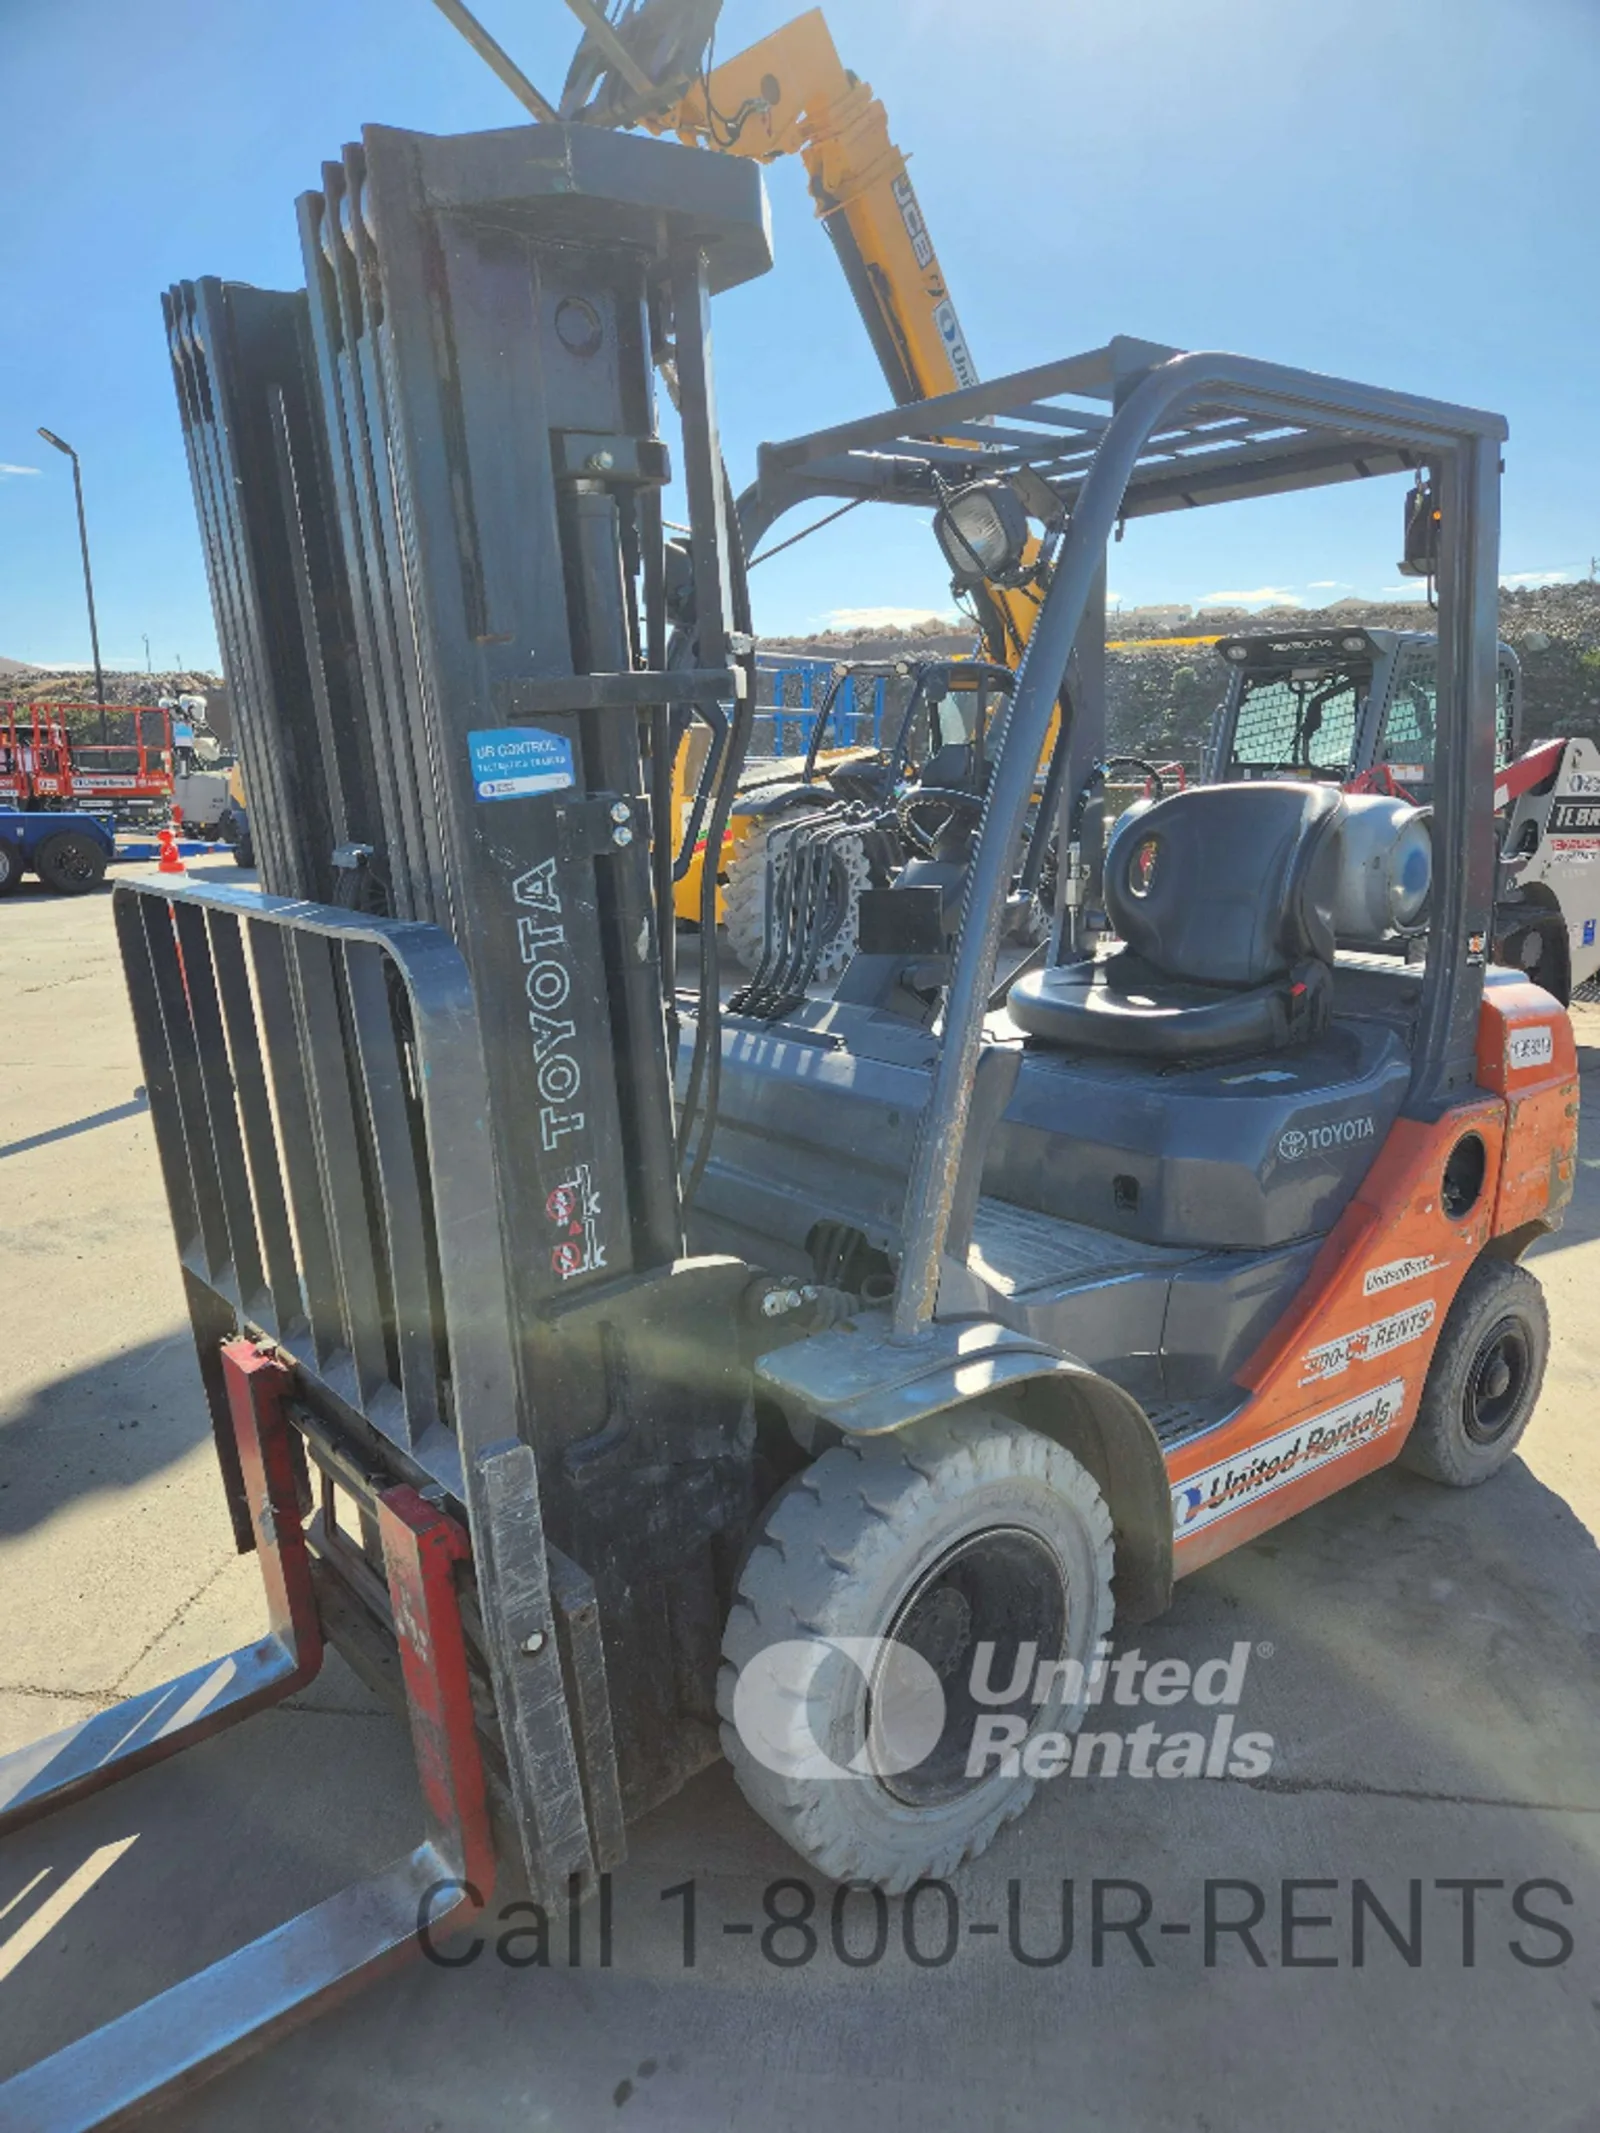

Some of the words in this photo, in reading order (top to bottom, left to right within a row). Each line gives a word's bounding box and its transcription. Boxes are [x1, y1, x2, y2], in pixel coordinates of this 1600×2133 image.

[894, 175, 933, 268] JCB
[512, 857, 584, 1151] TOYOTA
[1308, 1117, 1375, 1149] TOYOTA
[1208, 1437, 1301, 1509] United
[1304, 1398, 1391, 1463] Rentals
